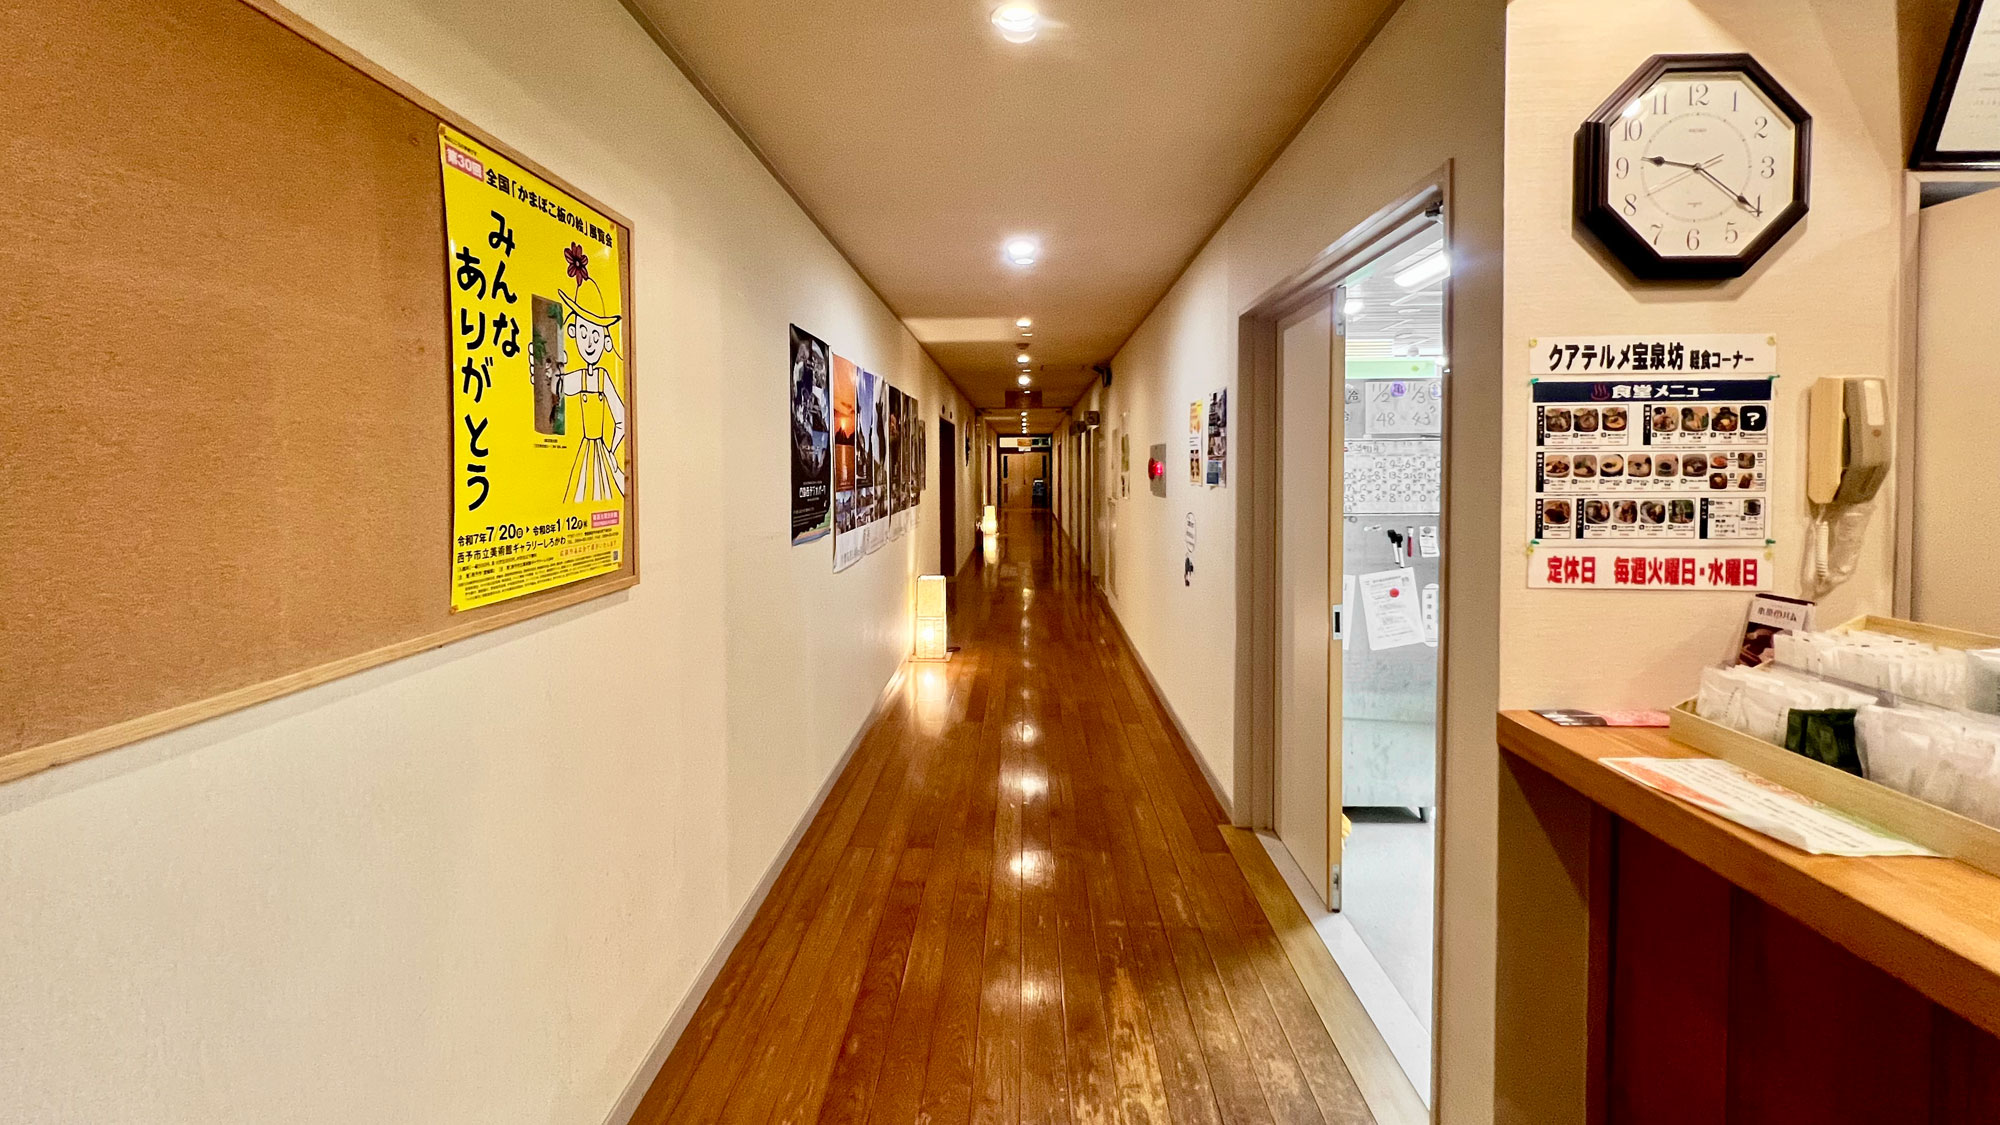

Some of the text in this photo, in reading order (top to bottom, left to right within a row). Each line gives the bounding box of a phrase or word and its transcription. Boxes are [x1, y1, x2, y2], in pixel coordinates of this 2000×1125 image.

[1653, 93, 1668, 115] 11
[1688, 83, 1709, 107] 12
[1732, 89, 1738, 113] 1
[1622, 119, 1643, 142] 10
[1754, 116, 1768, 139] 2
[1616, 157, 1630, 180] 9
[1760, 156, 1775, 179] 3
[1623, 193, 1637, 216] 8
[1749, 194, 1763, 218] 4
[1651, 223, 1664, 246] 7
[1686, 228, 1700, 251] 6
[1724, 222, 1738, 244] 5
[488, 210, 520, 358] みんな
[1549, 342, 1755, 371] クアテルメ宝泉坊 軽食コーナー
[455, 247, 493, 511] ありがとう
[1611, 384, 1716, 399] 食堂メニュー
[1376, 412, 1396, 427] 48
[457, 537, 566, 564] 西予市立美術館ギャラリーしろかわ
[1547, 555, 1758, 587] 定休日 毎週火曜日・水曜日
